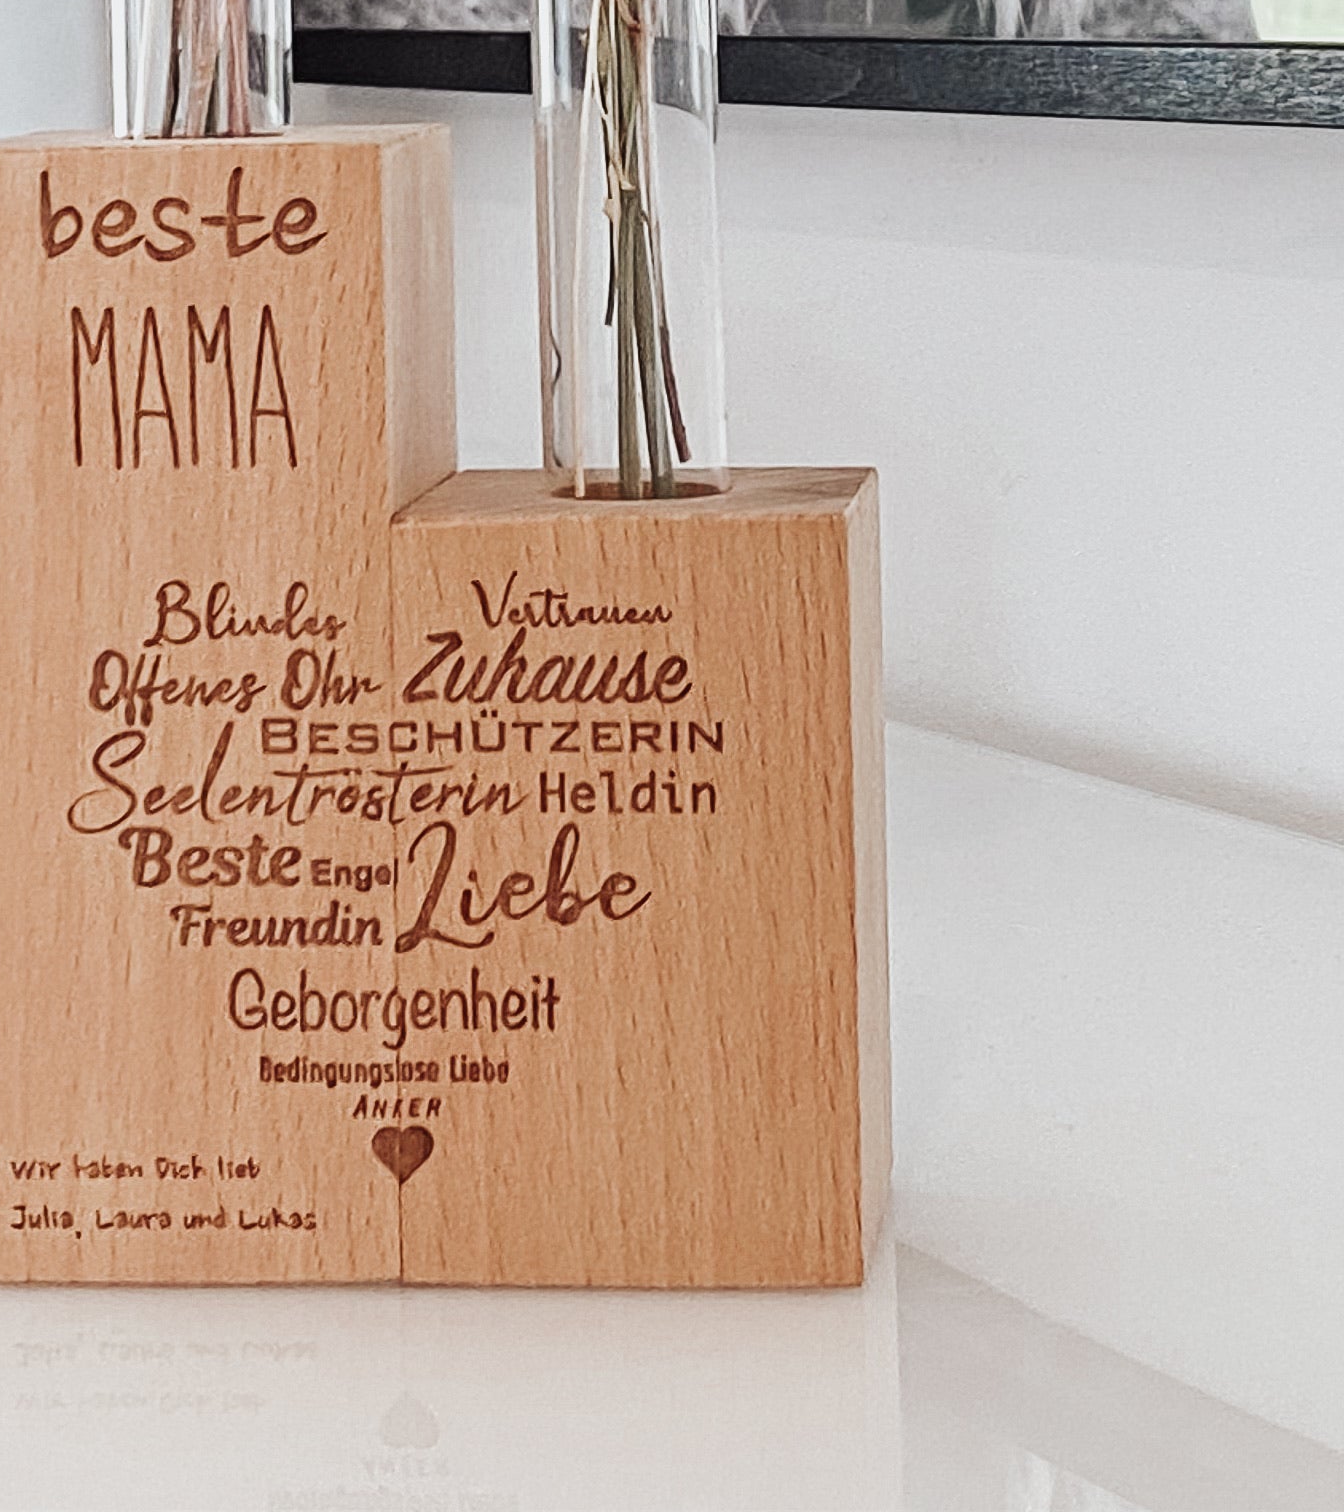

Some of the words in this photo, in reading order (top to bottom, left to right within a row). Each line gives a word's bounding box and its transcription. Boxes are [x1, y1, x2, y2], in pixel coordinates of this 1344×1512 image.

[38, 167, 328, 262] beste
[71, 304, 297, 470] MAMA
[144, 579, 347, 647] Blindes
[470, 571, 674, 628] Vertrauen
[89, 648, 268, 726] Offenes
[279, 648, 382, 710] Ohr
[402, 627, 694, 705] Zuhause
[261, 711, 724, 756] BESCHÜTZERIN
[67, 720, 526, 834] Seelentrösterin
[539, 769, 718, 815] Heldin
[118, 826, 302, 888] Beste
[394, 820, 652, 954] Liebe
[169, 900, 384, 948] Freundin
[228, 966, 560, 1050] Geborgenheit
[259, 1055, 440, 1088] Bedingungslose
[450, 1055, 510, 1085] Liebe
[353, 1094, 442, 1120] ANKER
[10, 1158, 60, 1182] Wir
[95, 1206, 172, 1230] Laura
[183, 1205, 226, 1230] und
[238, 1206, 317, 1231] Lukas
